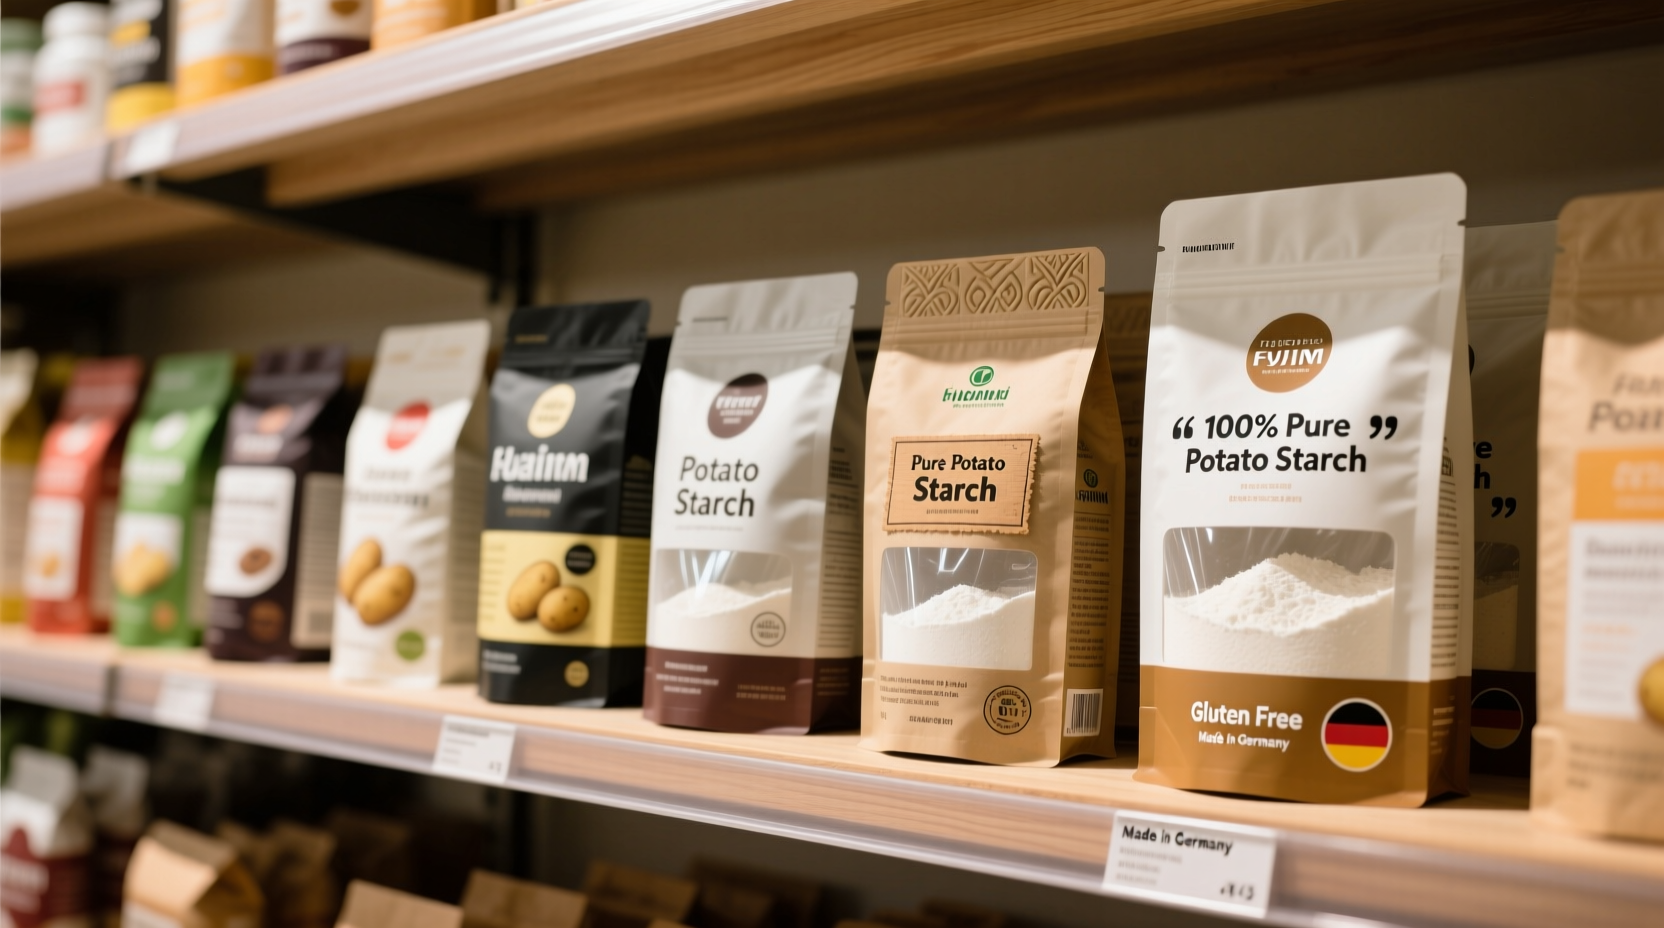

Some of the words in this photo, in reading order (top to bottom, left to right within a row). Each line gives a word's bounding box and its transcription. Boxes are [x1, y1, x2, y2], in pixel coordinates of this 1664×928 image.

[1205, 413, 1278, 439] 100%
[1286, 412, 1351, 438] Pure
[679, 456, 760, 483] Potato
[911, 454, 947, 471] Pure
[950, 454, 1006, 471] Potato
[1185, 447, 1269, 474] Potato
[1275, 444, 1367, 473] Starch
[674, 488, 755, 517] Starch
[912, 476, 997, 502] Starch
[1190, 700, 1250, 726] Gluten
[1255, 705, 1303, 730] Free
[1237, 733, 1290, 753] Germany
[1122, 825, 1157, 842] Made
[1161, 829, 1171, 844] in
[1174, 831, 1234, 857] Germany
